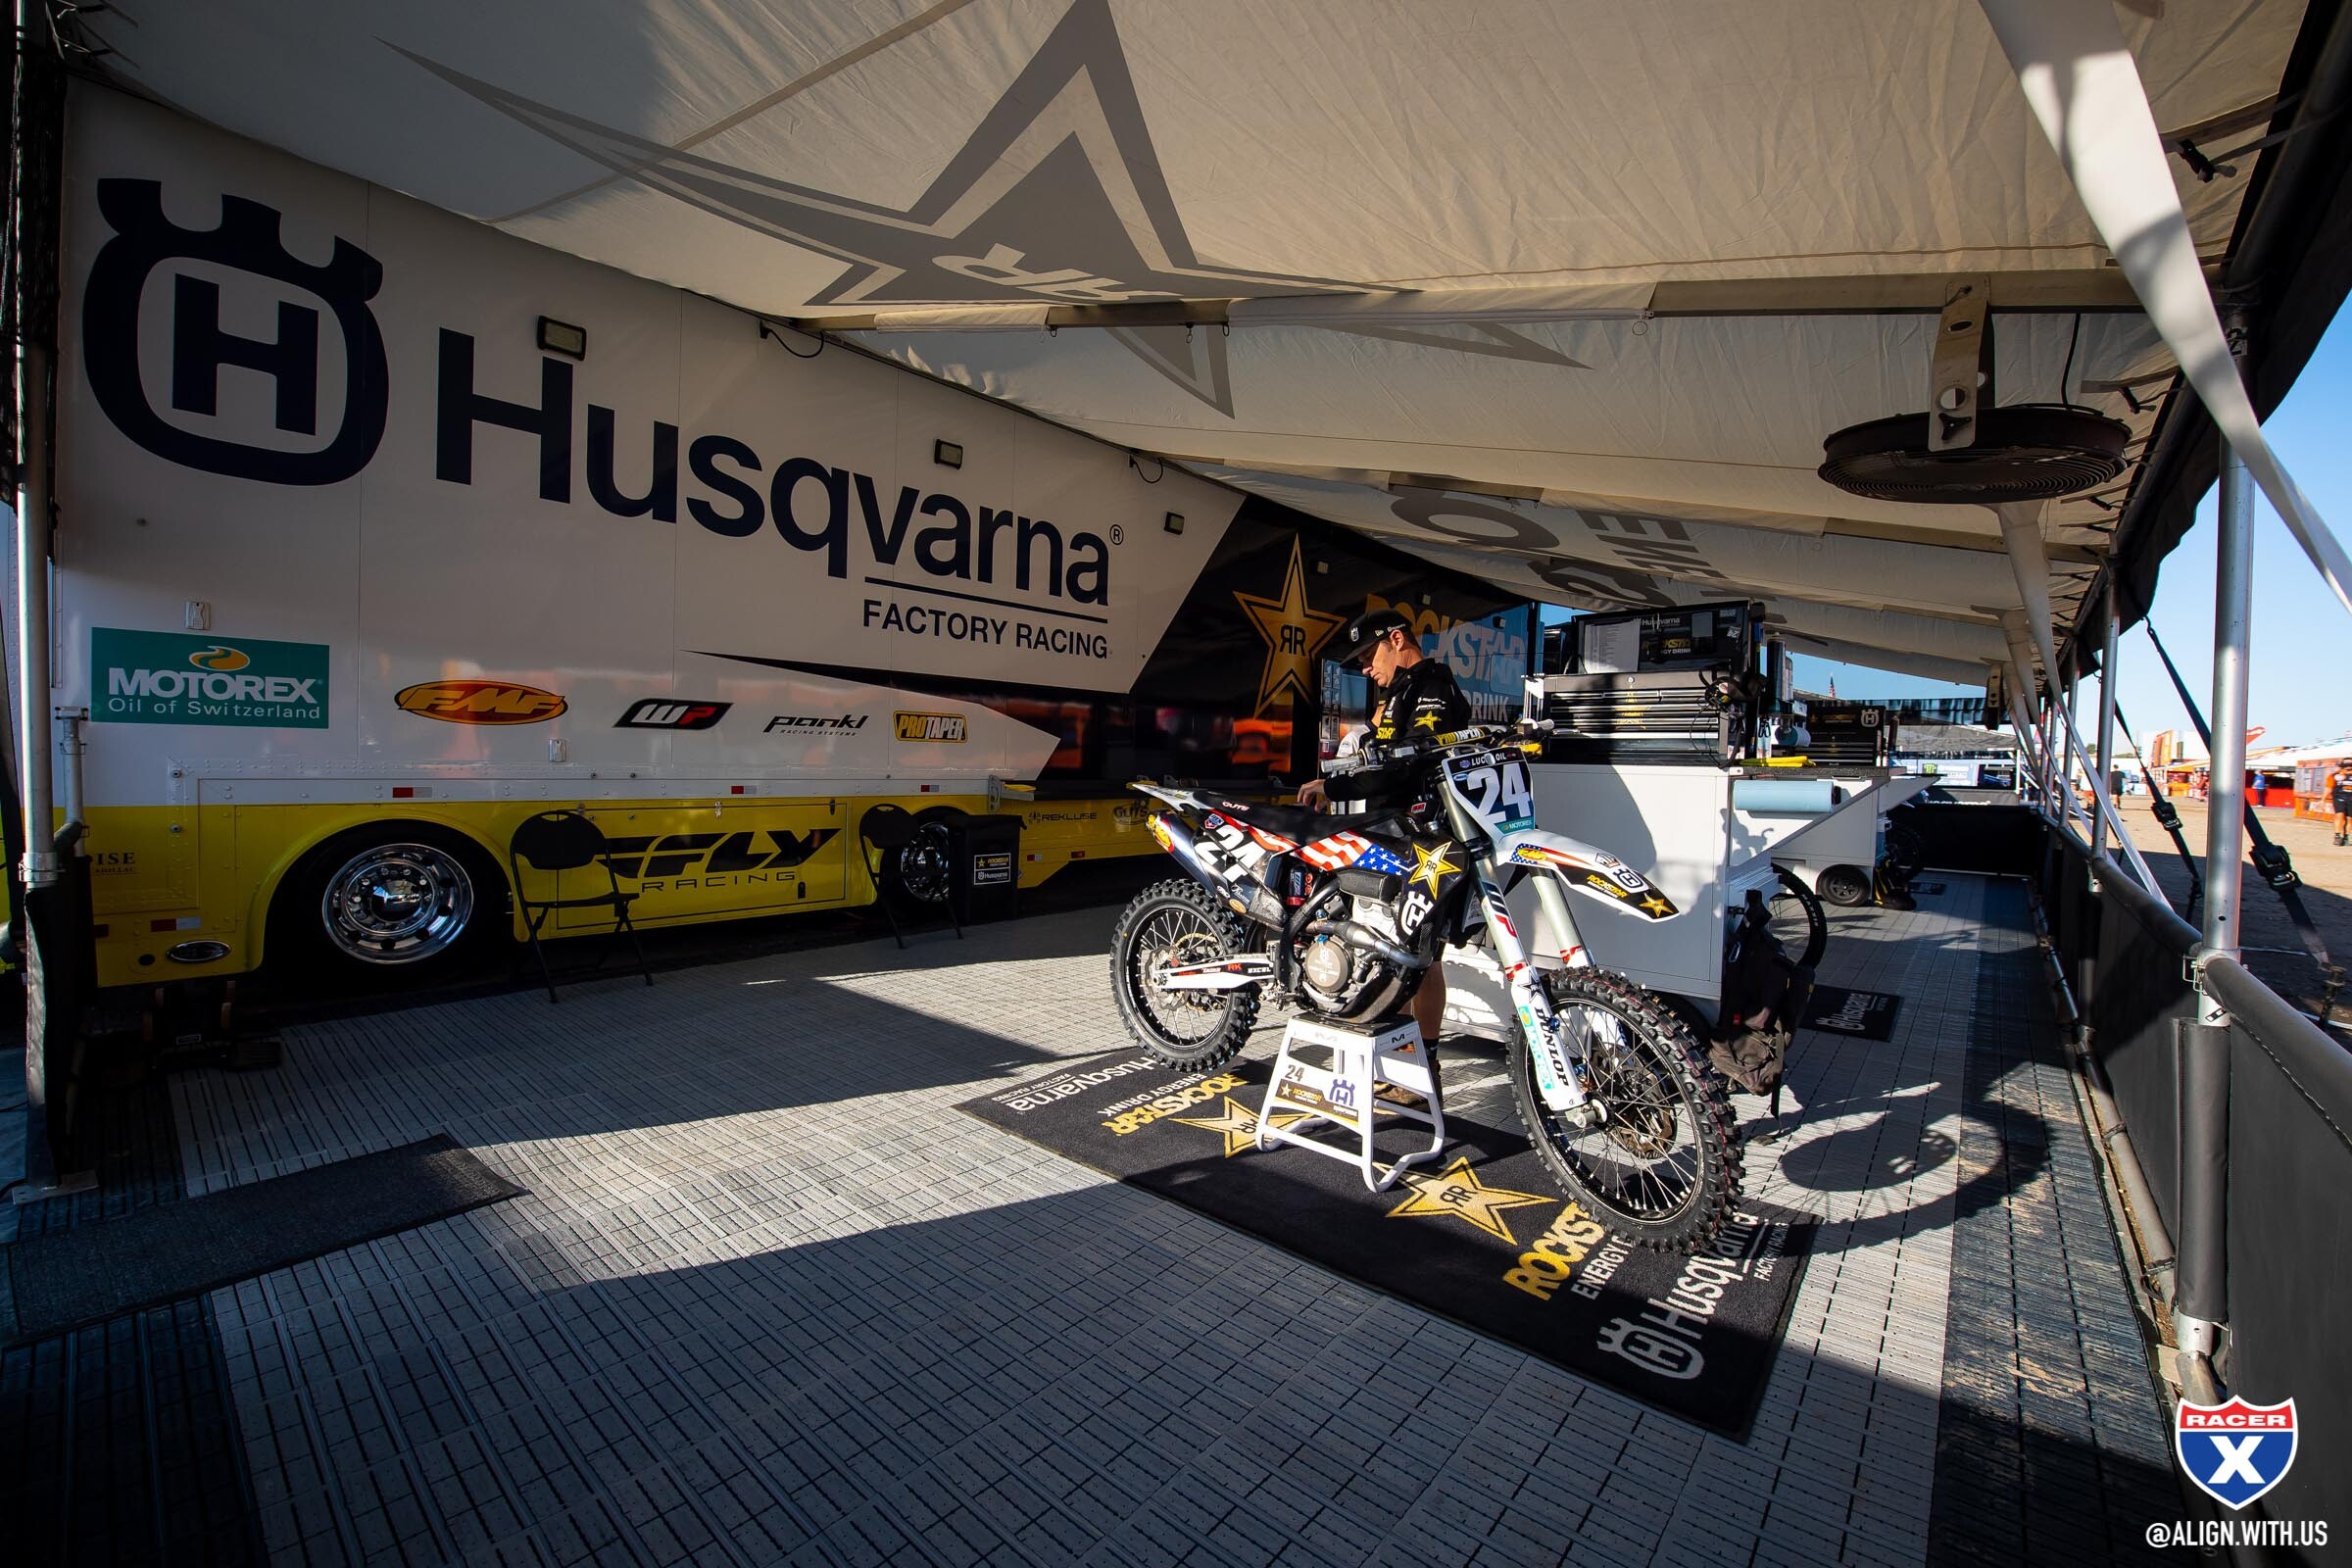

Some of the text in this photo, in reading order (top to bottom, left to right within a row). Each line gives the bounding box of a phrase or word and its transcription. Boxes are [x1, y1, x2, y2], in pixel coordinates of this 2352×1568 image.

[436, 327, 1110, 607] Husqvarna
[863, 599, 1109, 660] FACTORY RACING
[109, 667, 318, 704] MOTOREX
[398, 687, 565, 714] FMF
[108, 698, 320, 719] Oil of Switzerland
[630, 704, 717, 725] WP
[898, 714, 965, 740] PROTAPER
[1495, 753, 1507, 761] OIL
[1467, 762, 1531, 824] 24
[1042, 812, 1098, 821] REKLUSE
[1509, 819, 1534, 829] MOTOREX
[593, 828, 841, 878] FLY
[1194, 825, 1268, 883] 24
[641, 870, 797, 893] RACING
[1587, 874, 1629, 899] ROCKSTAR
[1227, 962, 1243, 971] RK
[1535, 1006, 1569, 1087] DUNLOP
[1005, 1056, 1157, 1112] Husqvarna
[1285, 1064, 1304, 1082] 24
[1097, 1072, 1208, 1118] ENERGY DRINK
[1101, 1073, 1250, 1137] ROCKSTAR
[1502, 1200, 1606, 1301] ROCKST
[1570, 1235, 1630, 1300] ENERGY
